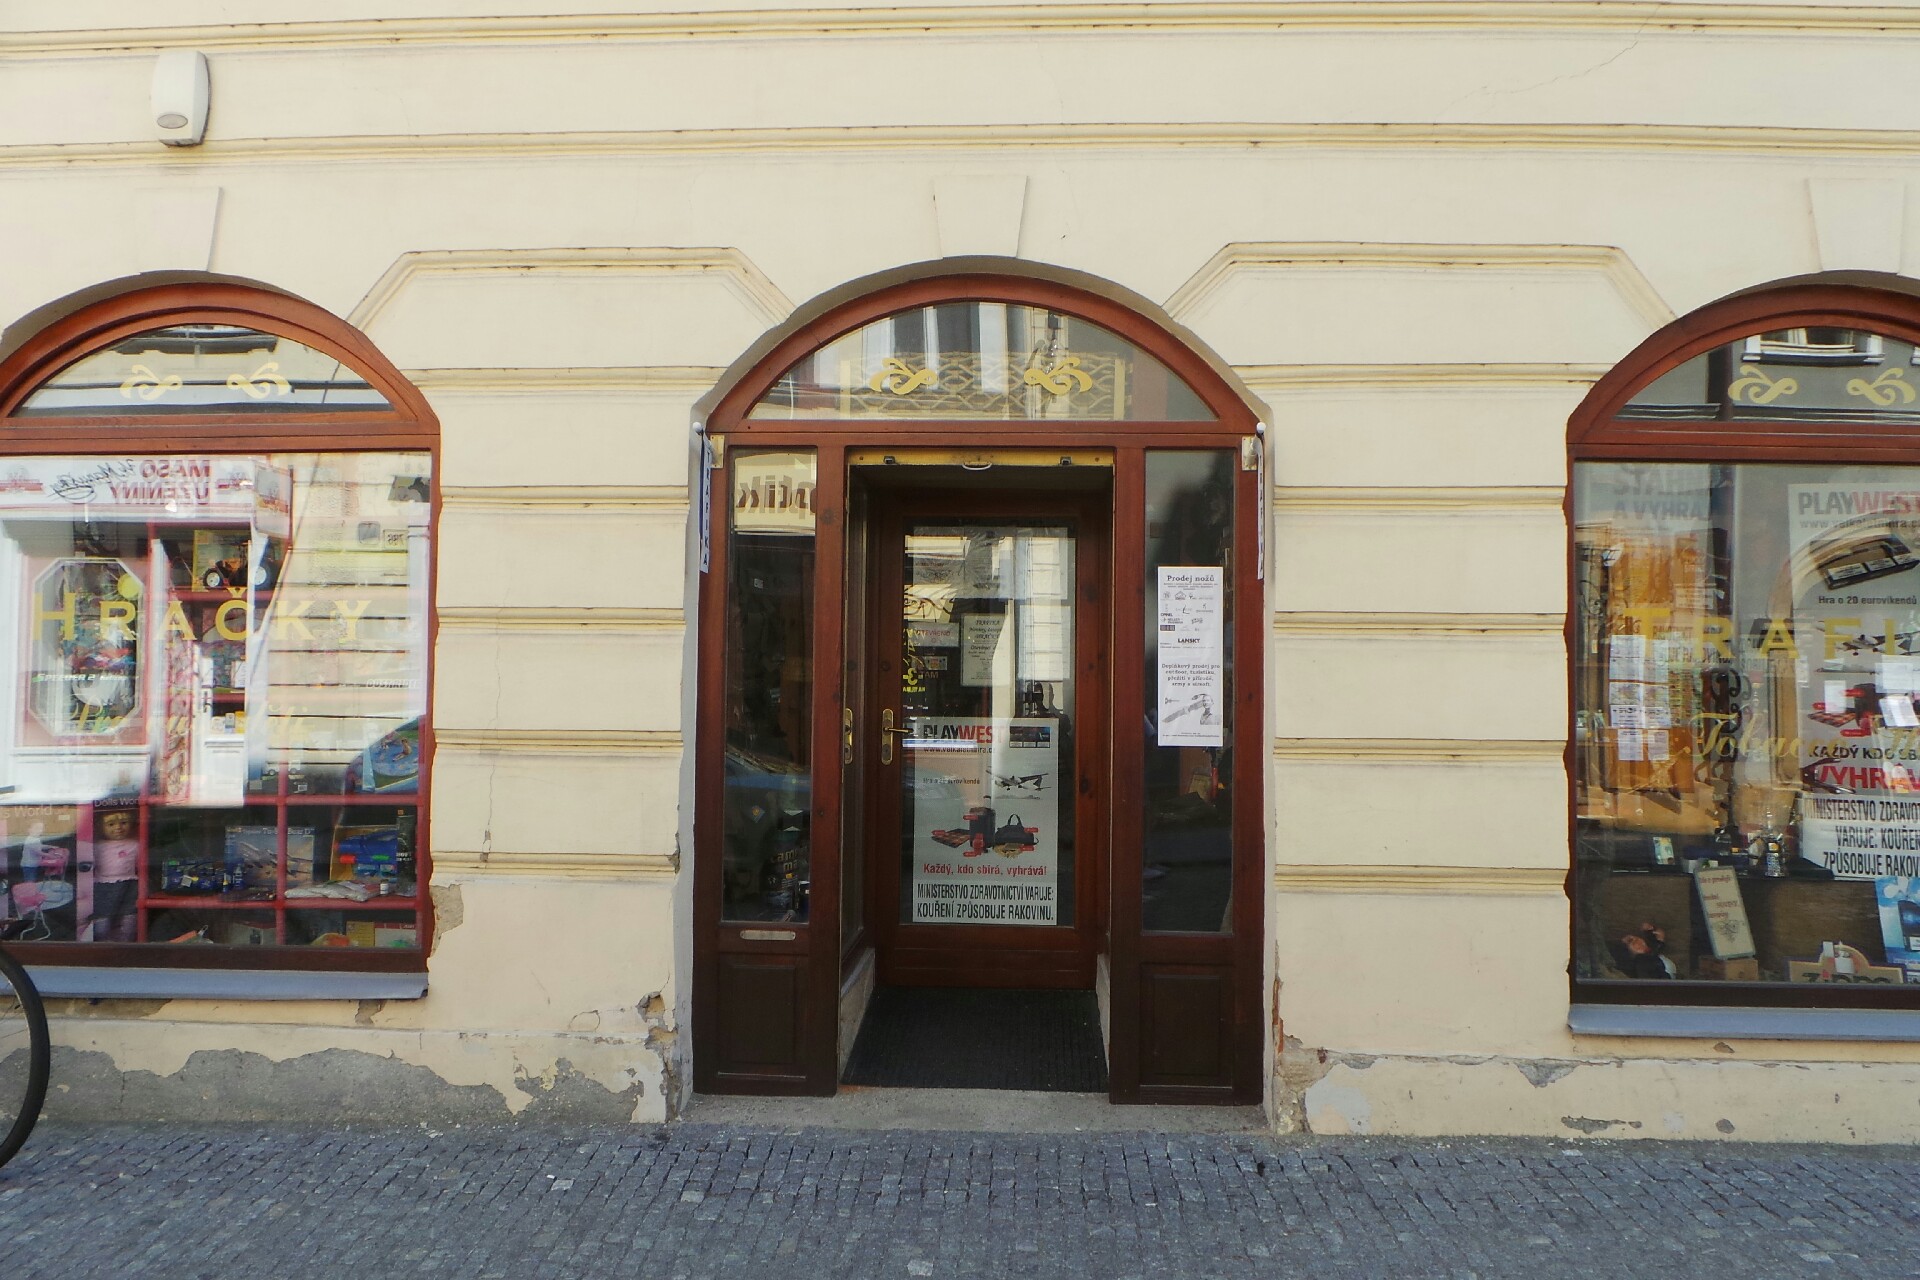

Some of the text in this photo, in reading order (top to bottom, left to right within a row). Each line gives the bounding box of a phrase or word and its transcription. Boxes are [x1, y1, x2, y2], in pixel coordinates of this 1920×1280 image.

[703, 451, 711, 566] TRAFIKA
[1167, 575, 1193, 584] Prodej
[1818, 596, 1836, 605] Hra
[1838, 597, 1844, 605] o
[1847, 596, 1859, 605] 20
[33, 586, 373, 641] HRAČKY
[1809, 744, 1920, 760] KAŽDÝ KDO SB
[923, 863, 1047, 878] Každý, kdo sbírá, vyhrává!
[917, 883, 1054, 901] MINISTERSTVO ZDRAVOTNICTVÍ VARUJE:
[917, 900, 1054, 921] KOUŘENÍ ZPŮSOBUJE RAKOVINU.
